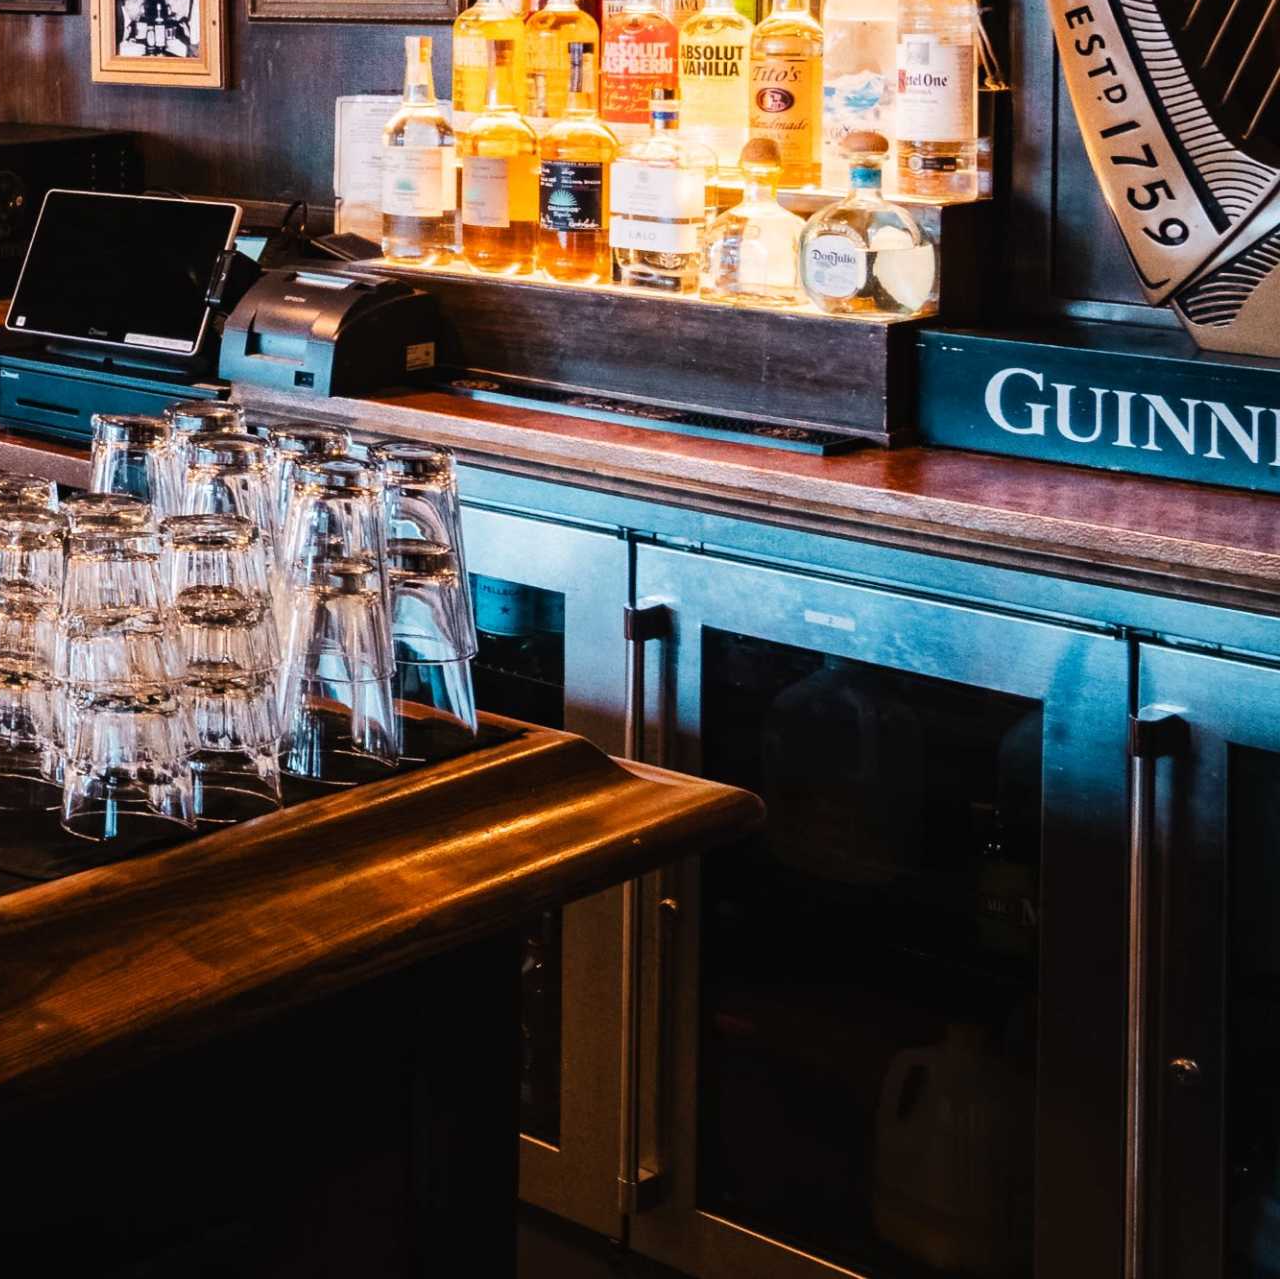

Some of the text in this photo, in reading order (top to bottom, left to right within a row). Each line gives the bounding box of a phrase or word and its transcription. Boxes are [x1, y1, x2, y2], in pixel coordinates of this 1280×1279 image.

[681, 44, 745, 61] ABSOLUT
[682, 61, 740, 77] VANILIA
[752, 66, 802, 82] Tito's
[923, 73, 949, 87] One
[1100, 120, 1190, 247] 1759
[811, 249, 857, 266] Don Julio
